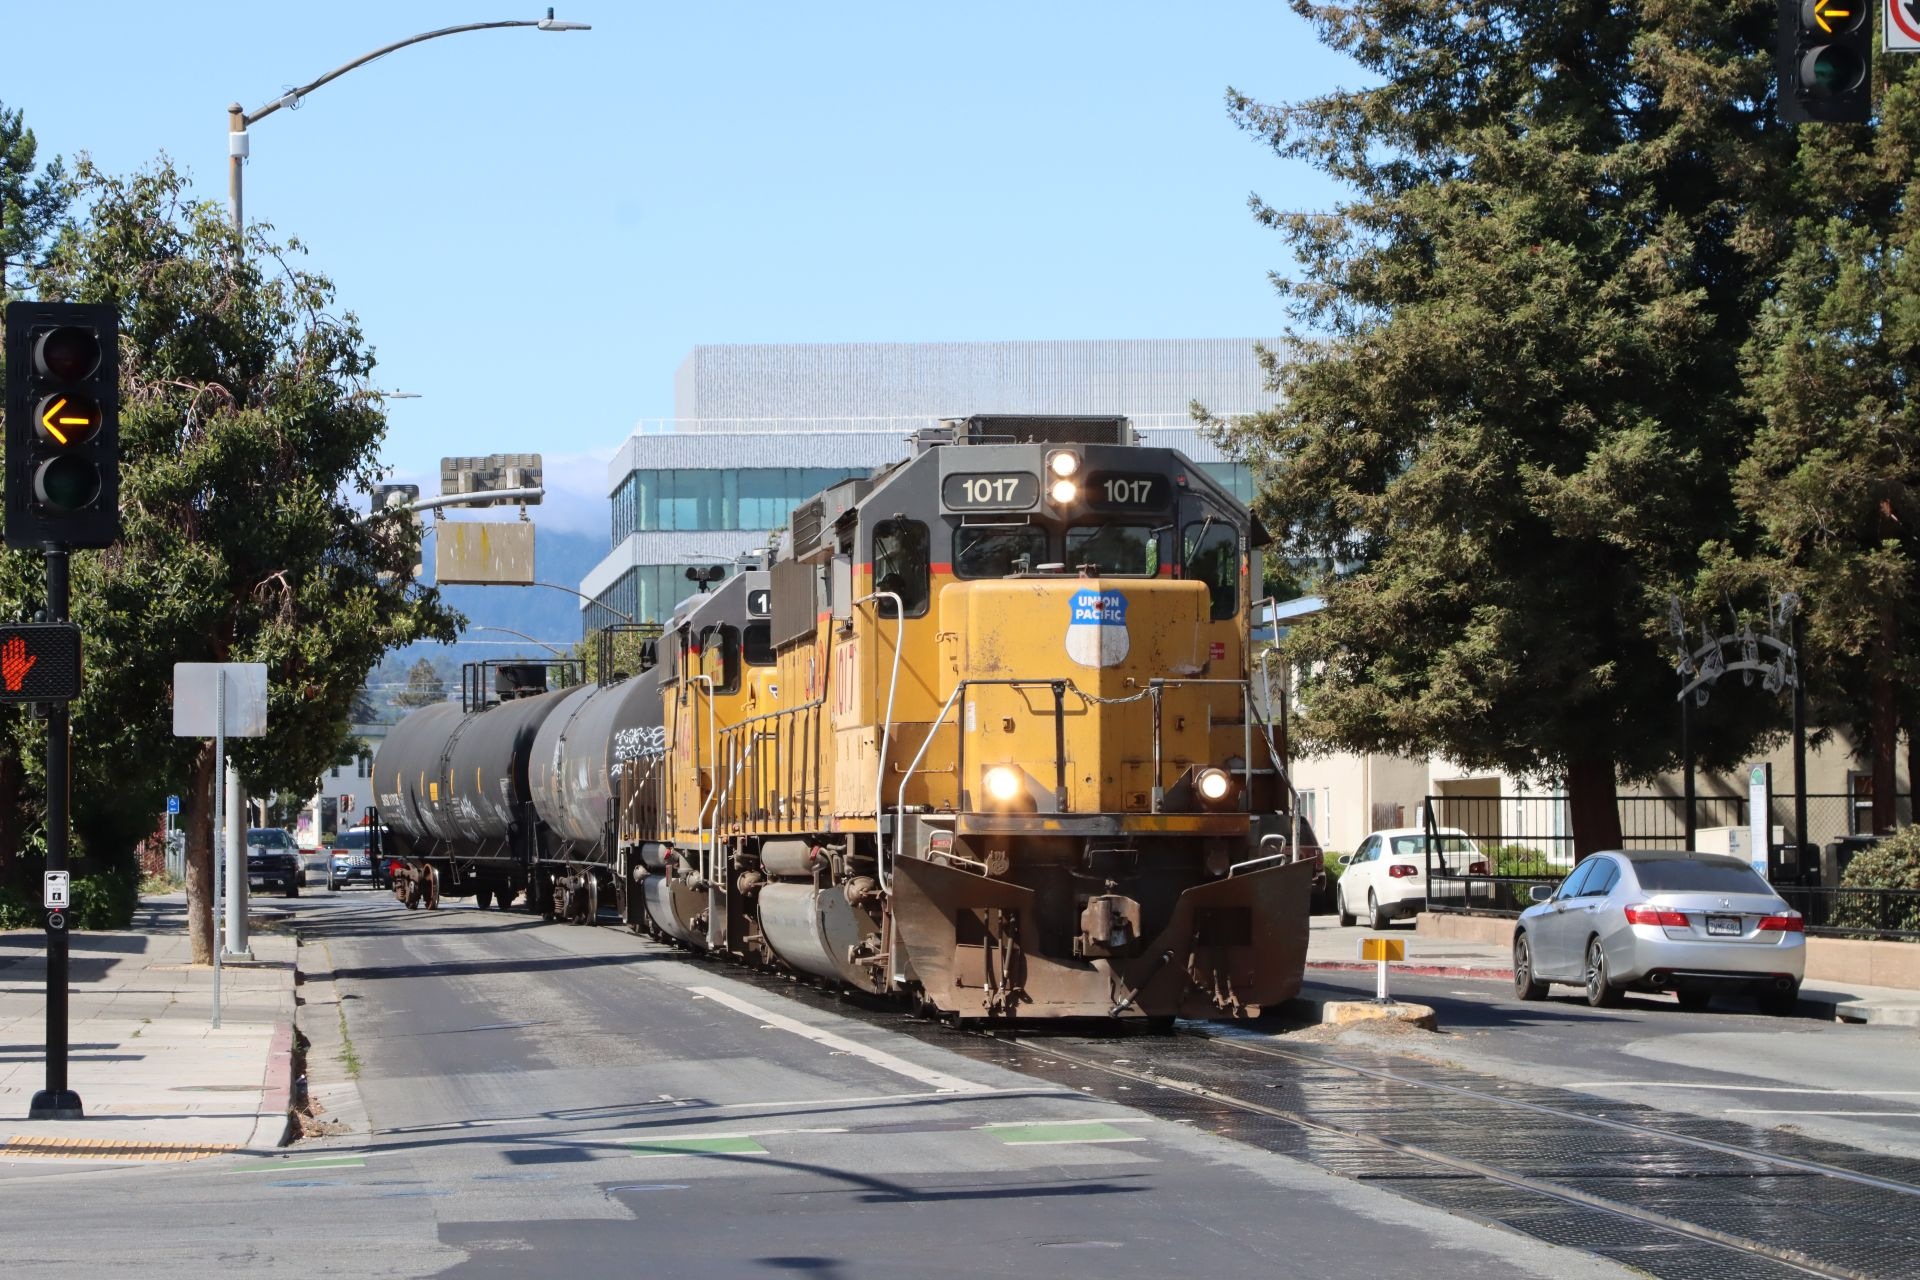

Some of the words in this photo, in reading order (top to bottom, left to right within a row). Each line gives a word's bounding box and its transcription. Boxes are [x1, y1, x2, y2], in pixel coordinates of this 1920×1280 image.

[962, 478, 1019, 503] 1017
[1103, 479, 1152, 503] 1017
[757, 593, 772, 613] 1
[1075, 608, 1122, 620] PACIFIC
